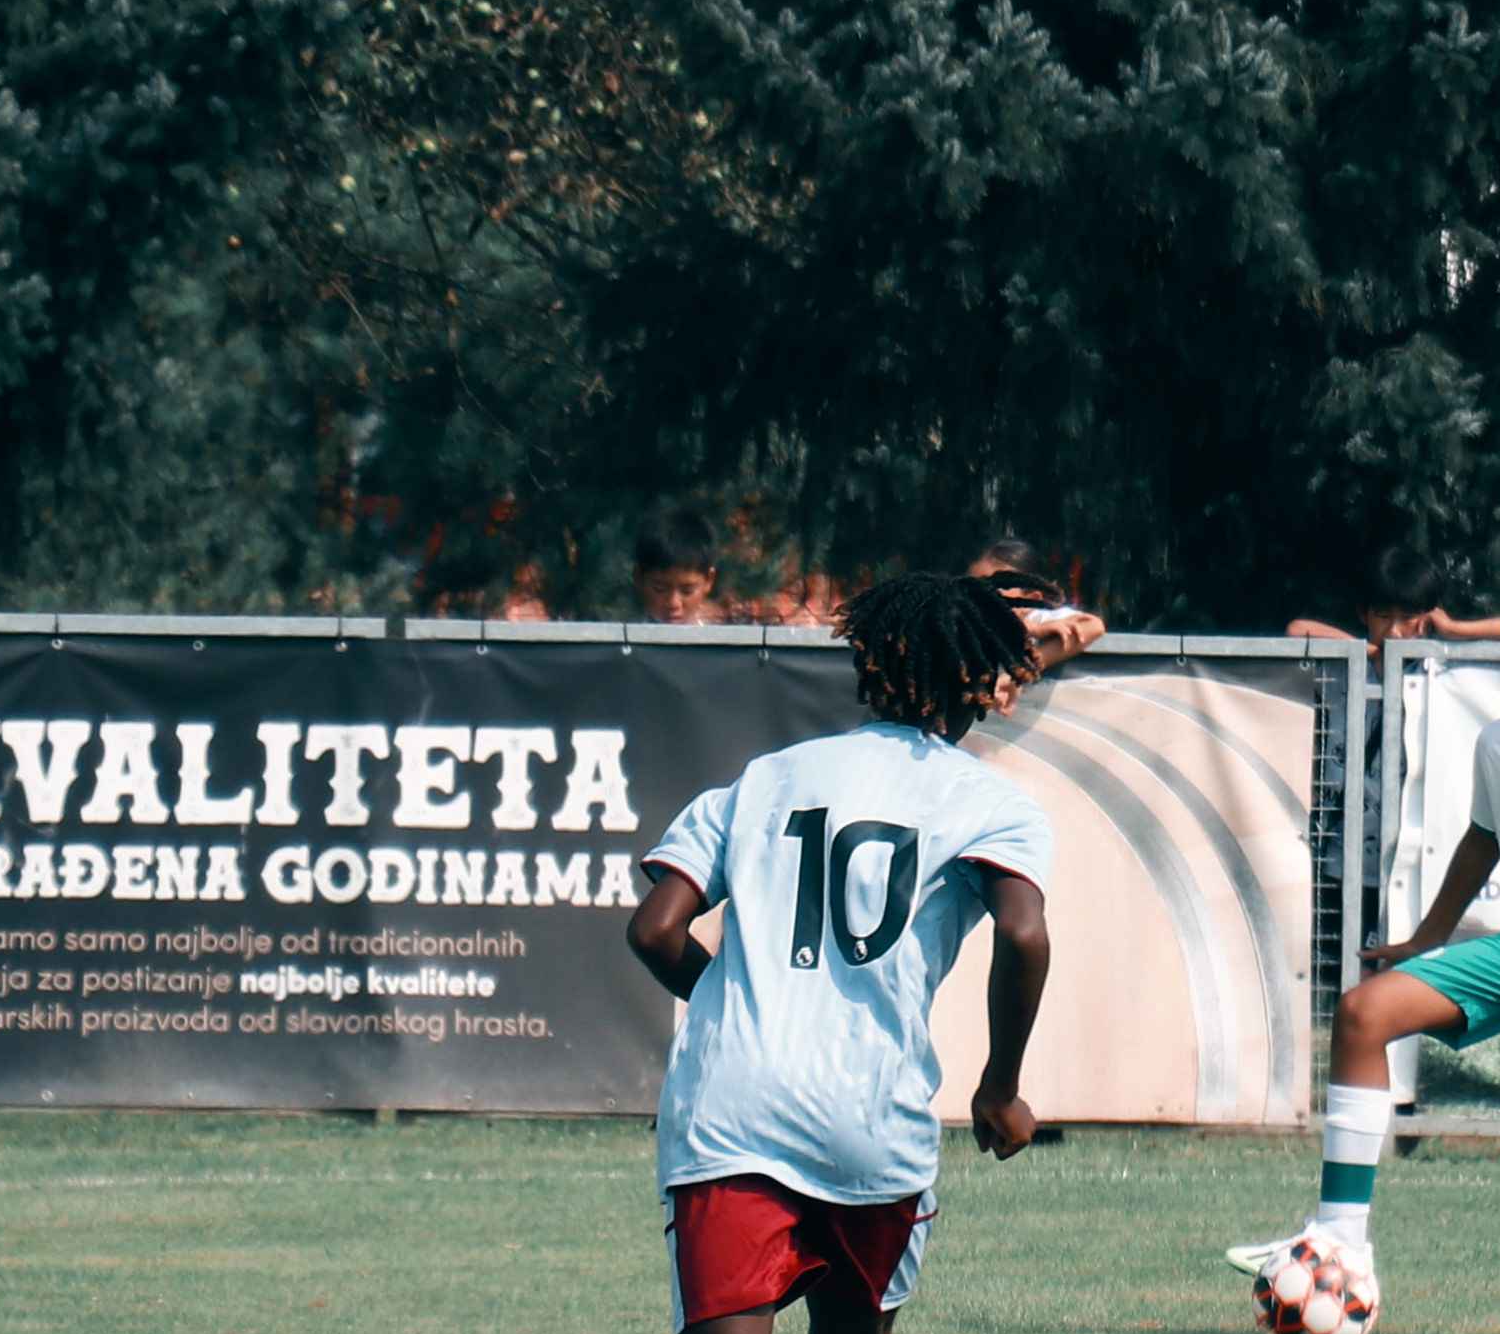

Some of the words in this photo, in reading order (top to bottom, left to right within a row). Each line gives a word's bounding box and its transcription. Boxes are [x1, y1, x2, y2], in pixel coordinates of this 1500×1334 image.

[260, 846, 640, 907] GODINAMA
[783, 807, 920, 970] 10
[63, 930, 146, 953] samo
[155, 925, 273, 960] najbolje
[280, 928, 320, 953] od
[329, 928, 526, 958] tradicionalnih
[36, 970, 74, 992] za
[82, 966, 233, 1001] postizanje
[240, 966, 360, 1002] najbolje
[367, 967, 496, 998] kvalitete
[81, 1006, 232, 1037] proizvoda
[239, 1008, 278, 1034] od
[285, 1007, 447, 1043] slavonskog
[454, 1009, 555, 1038] hrasta.
